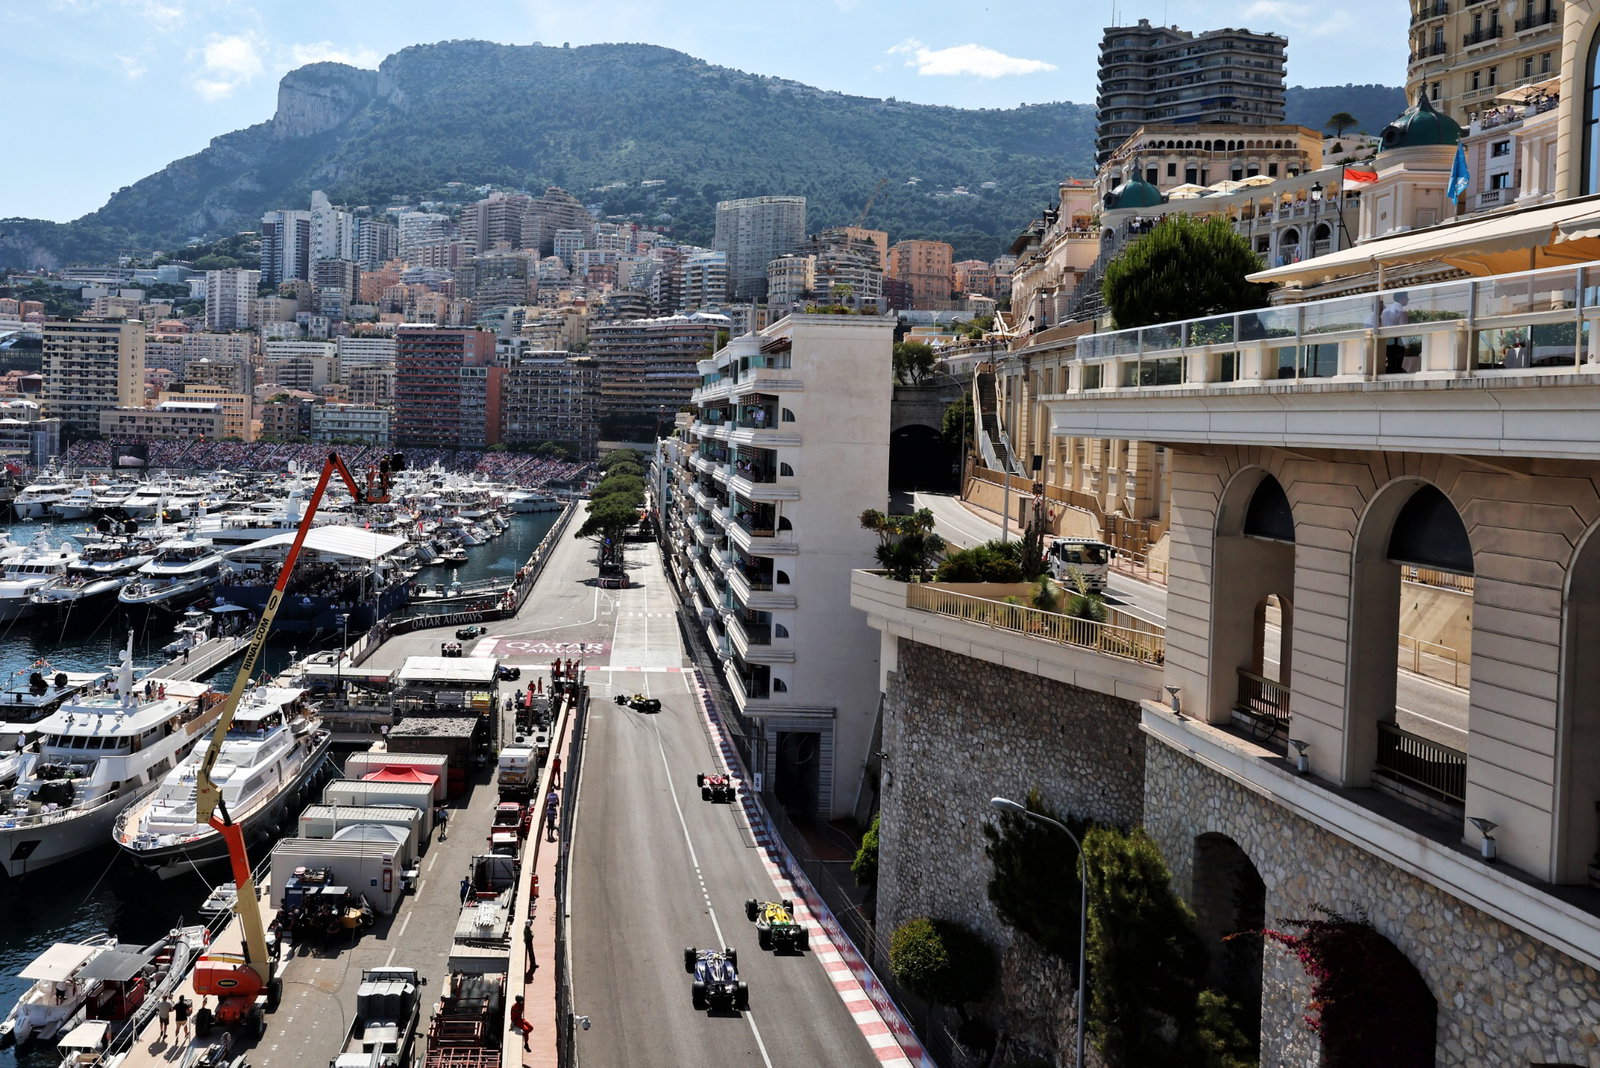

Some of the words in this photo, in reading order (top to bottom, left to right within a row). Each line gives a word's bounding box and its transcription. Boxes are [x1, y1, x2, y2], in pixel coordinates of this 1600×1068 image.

[411, 616, 441, 630] QATAR
[443, 613, 483, 625] AIRWAYS
[243, 617, 270, 671] RIWAL.COM
[505, 641, 604, 651] QATAR
